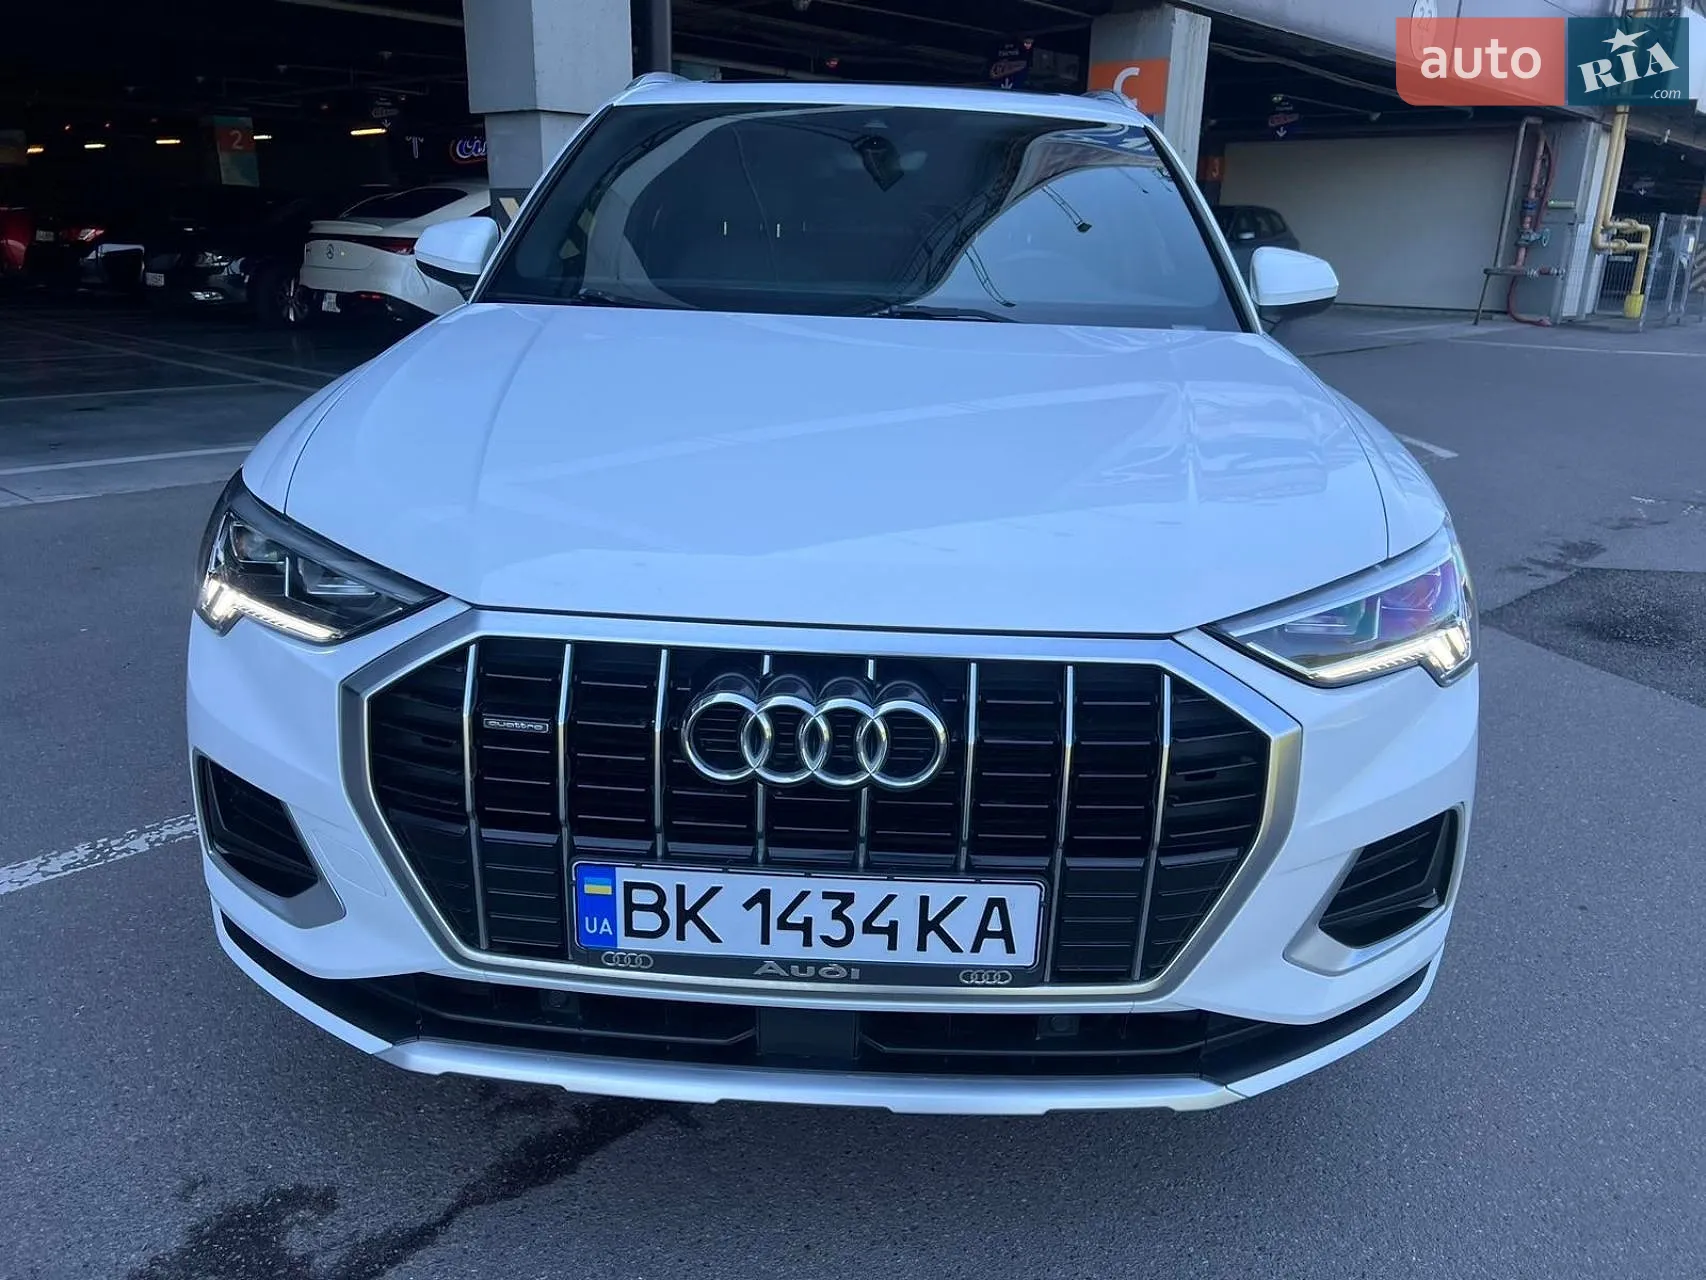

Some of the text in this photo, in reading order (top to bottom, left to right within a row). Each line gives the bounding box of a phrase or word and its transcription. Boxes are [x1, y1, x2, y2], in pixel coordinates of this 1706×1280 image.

[229, 129, 244, 150] 2
[487, 720, 543, 731] quattro
[584, 916, 613, 936] UA
[622, 879, 1017, 955] BK 1434 KA
